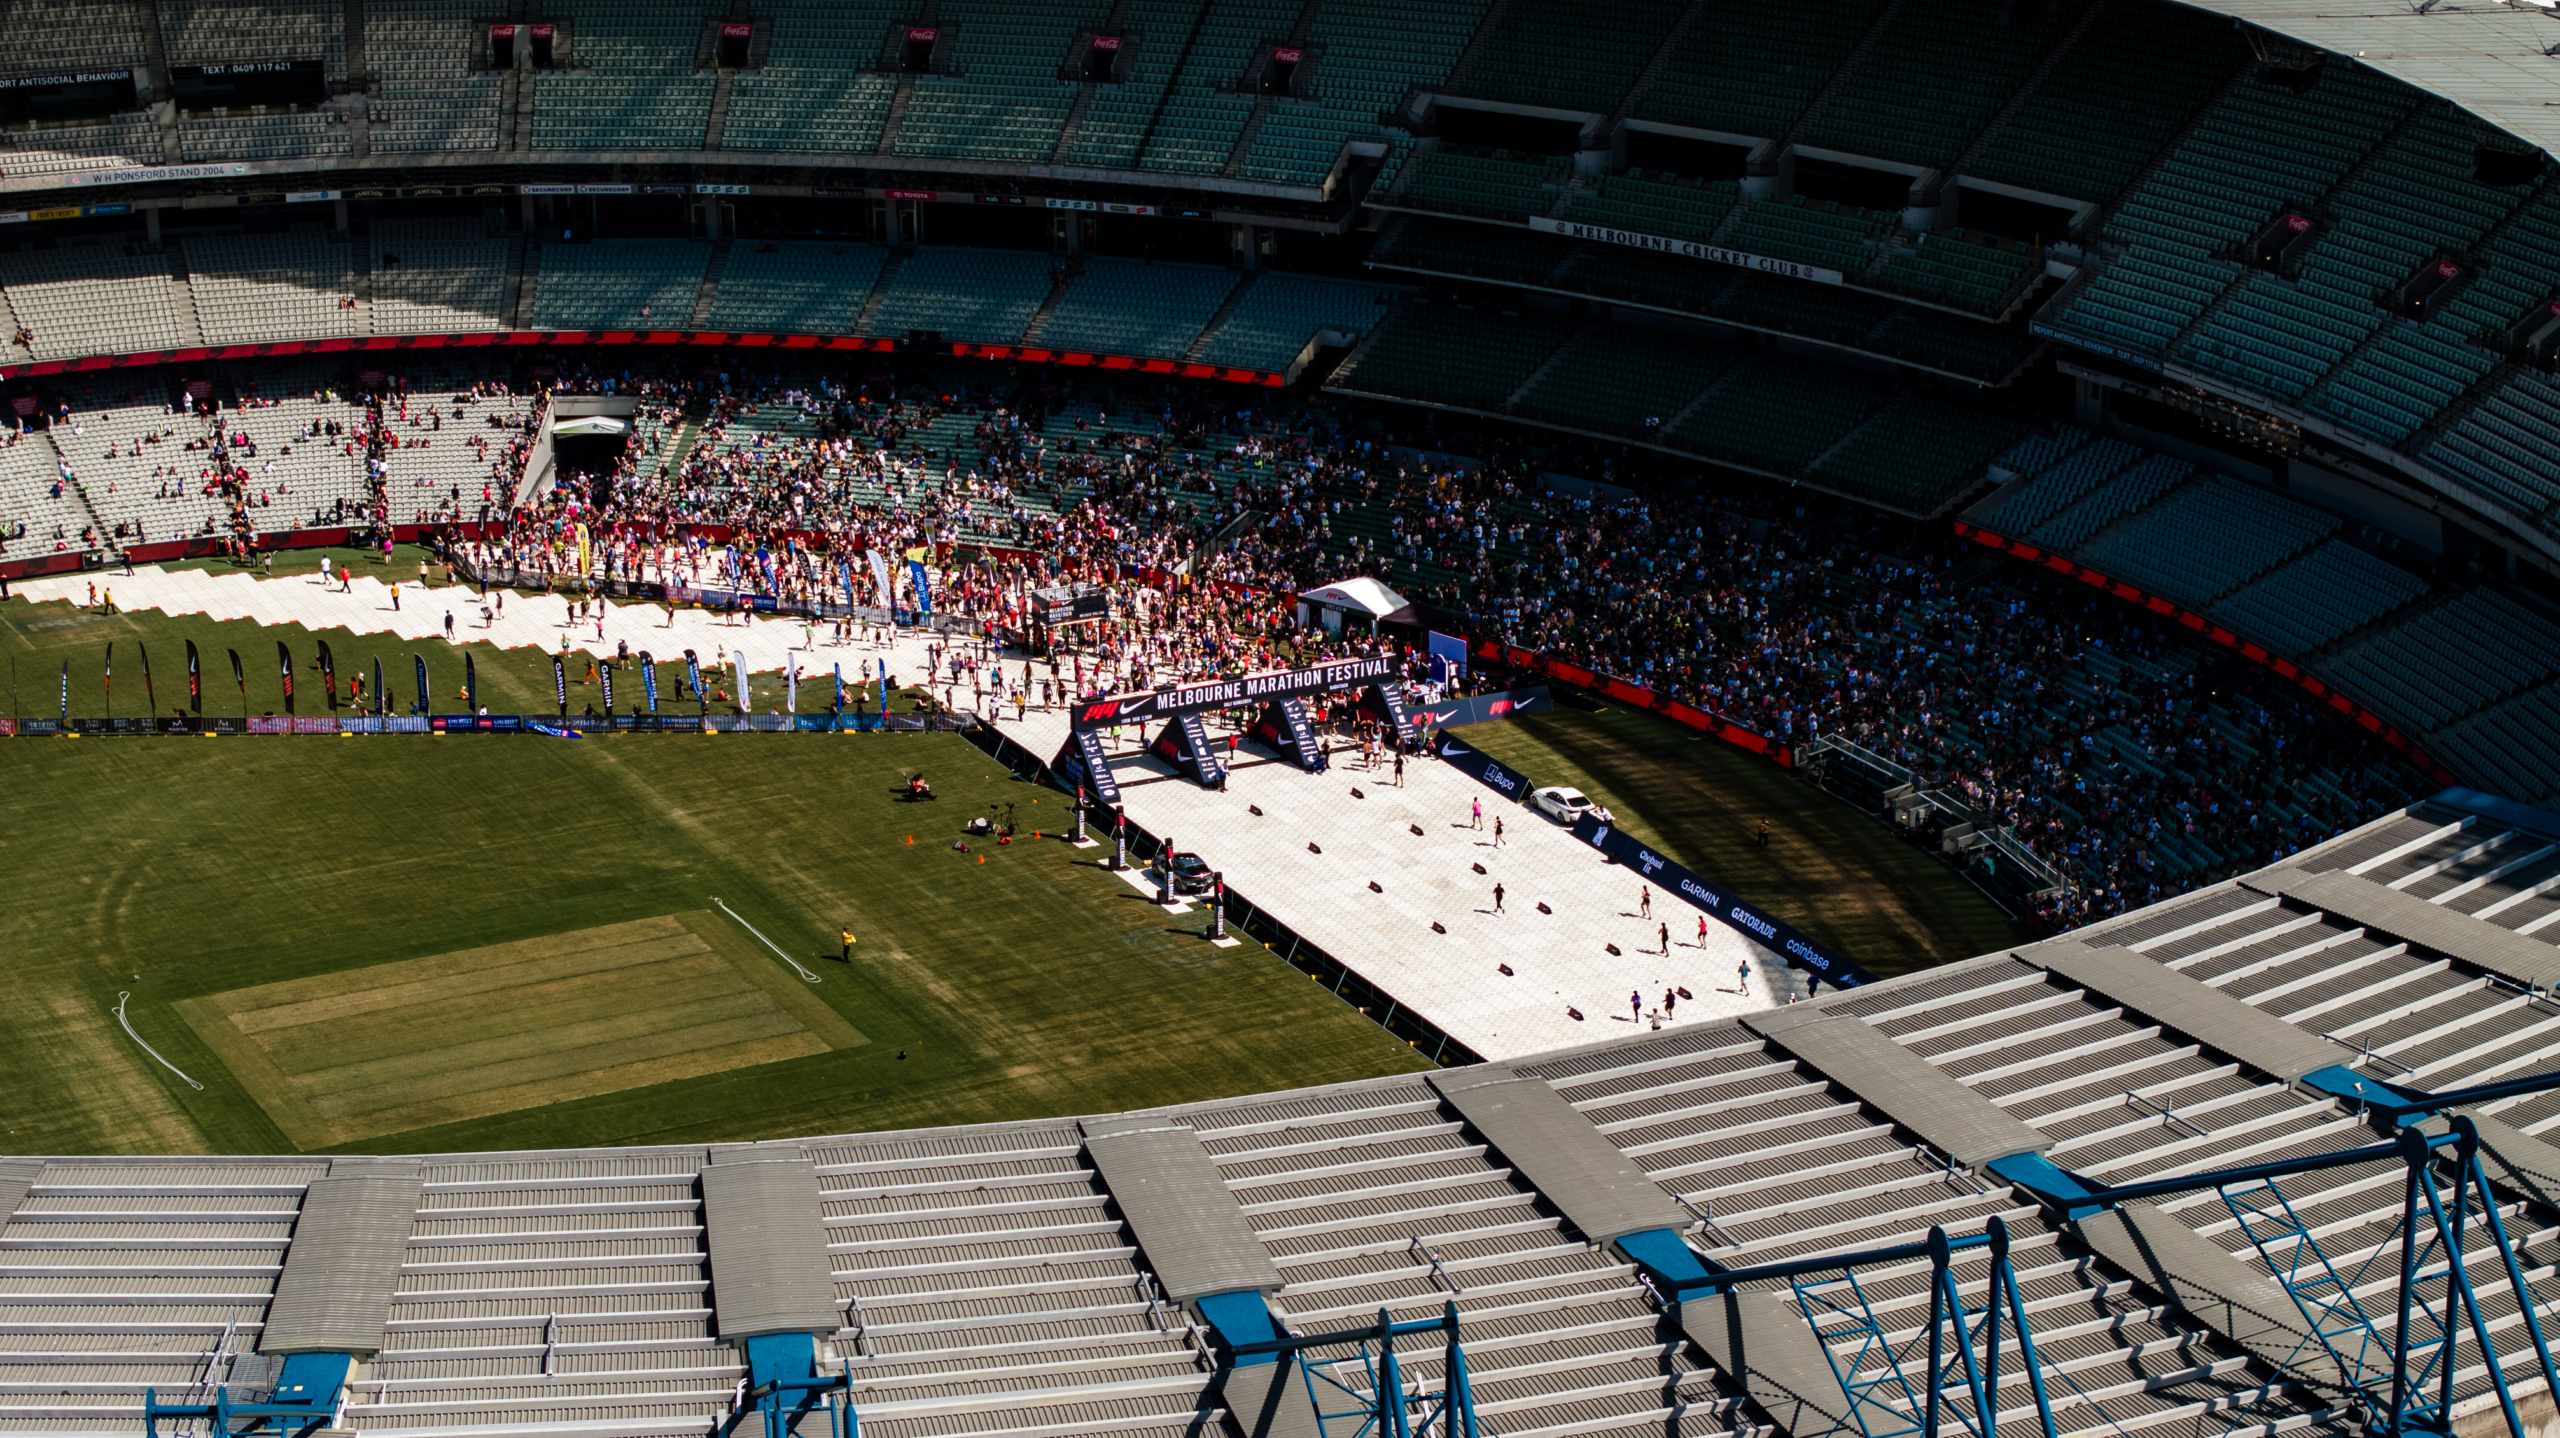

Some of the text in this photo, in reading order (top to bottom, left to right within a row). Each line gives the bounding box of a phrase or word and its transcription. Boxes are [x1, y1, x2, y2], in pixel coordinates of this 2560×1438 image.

[202, 65, 225, 74] TEXT
[232, 64, 255, 73] 0409
[257, 63, 273, 72] 117
[275, 62, 291, 71] 621
[19, 75, 75, 87] ANTISOCIAL
[76, 71, 130, 83] BEHAVIOUR
[93, 166, 225, 184] W H PONSFORD STAND 2004
[354, 190, 384, 198] JAMESON
[413, 188, 443, 197] JAMESON
[473, 186, 503, 196] JAMESON
[1572, 224, 1799, 277] MELBOURNE CRICKET CLUB
[2033, 325, 2053, 337] REPORT
[2053, 332, 2083, 347] ANTISOCIAL
[2083, 340, 2114, 355] BEHAVIOUR
[2117, 350, 2130, 360] TEXT
[915, 571, 926, 592] Bupa
[555, 662, 566, 705] GARMIN
[601, 665, 613, 707] GARMIN
[1157, 658, 1391, 710] MELBOURNE MARATHON FESTIVAL
[1494, 771, 1516, 791] Bupa
[1639, 850, 1665, 871] Chobani
[1642, 862, 1652, 875] fit
[1680, 878, 1719, 908] GARMIN
[1731, 906, 1778, 940] GATORADE
[1786, 939, 1830, 971] coinbase
